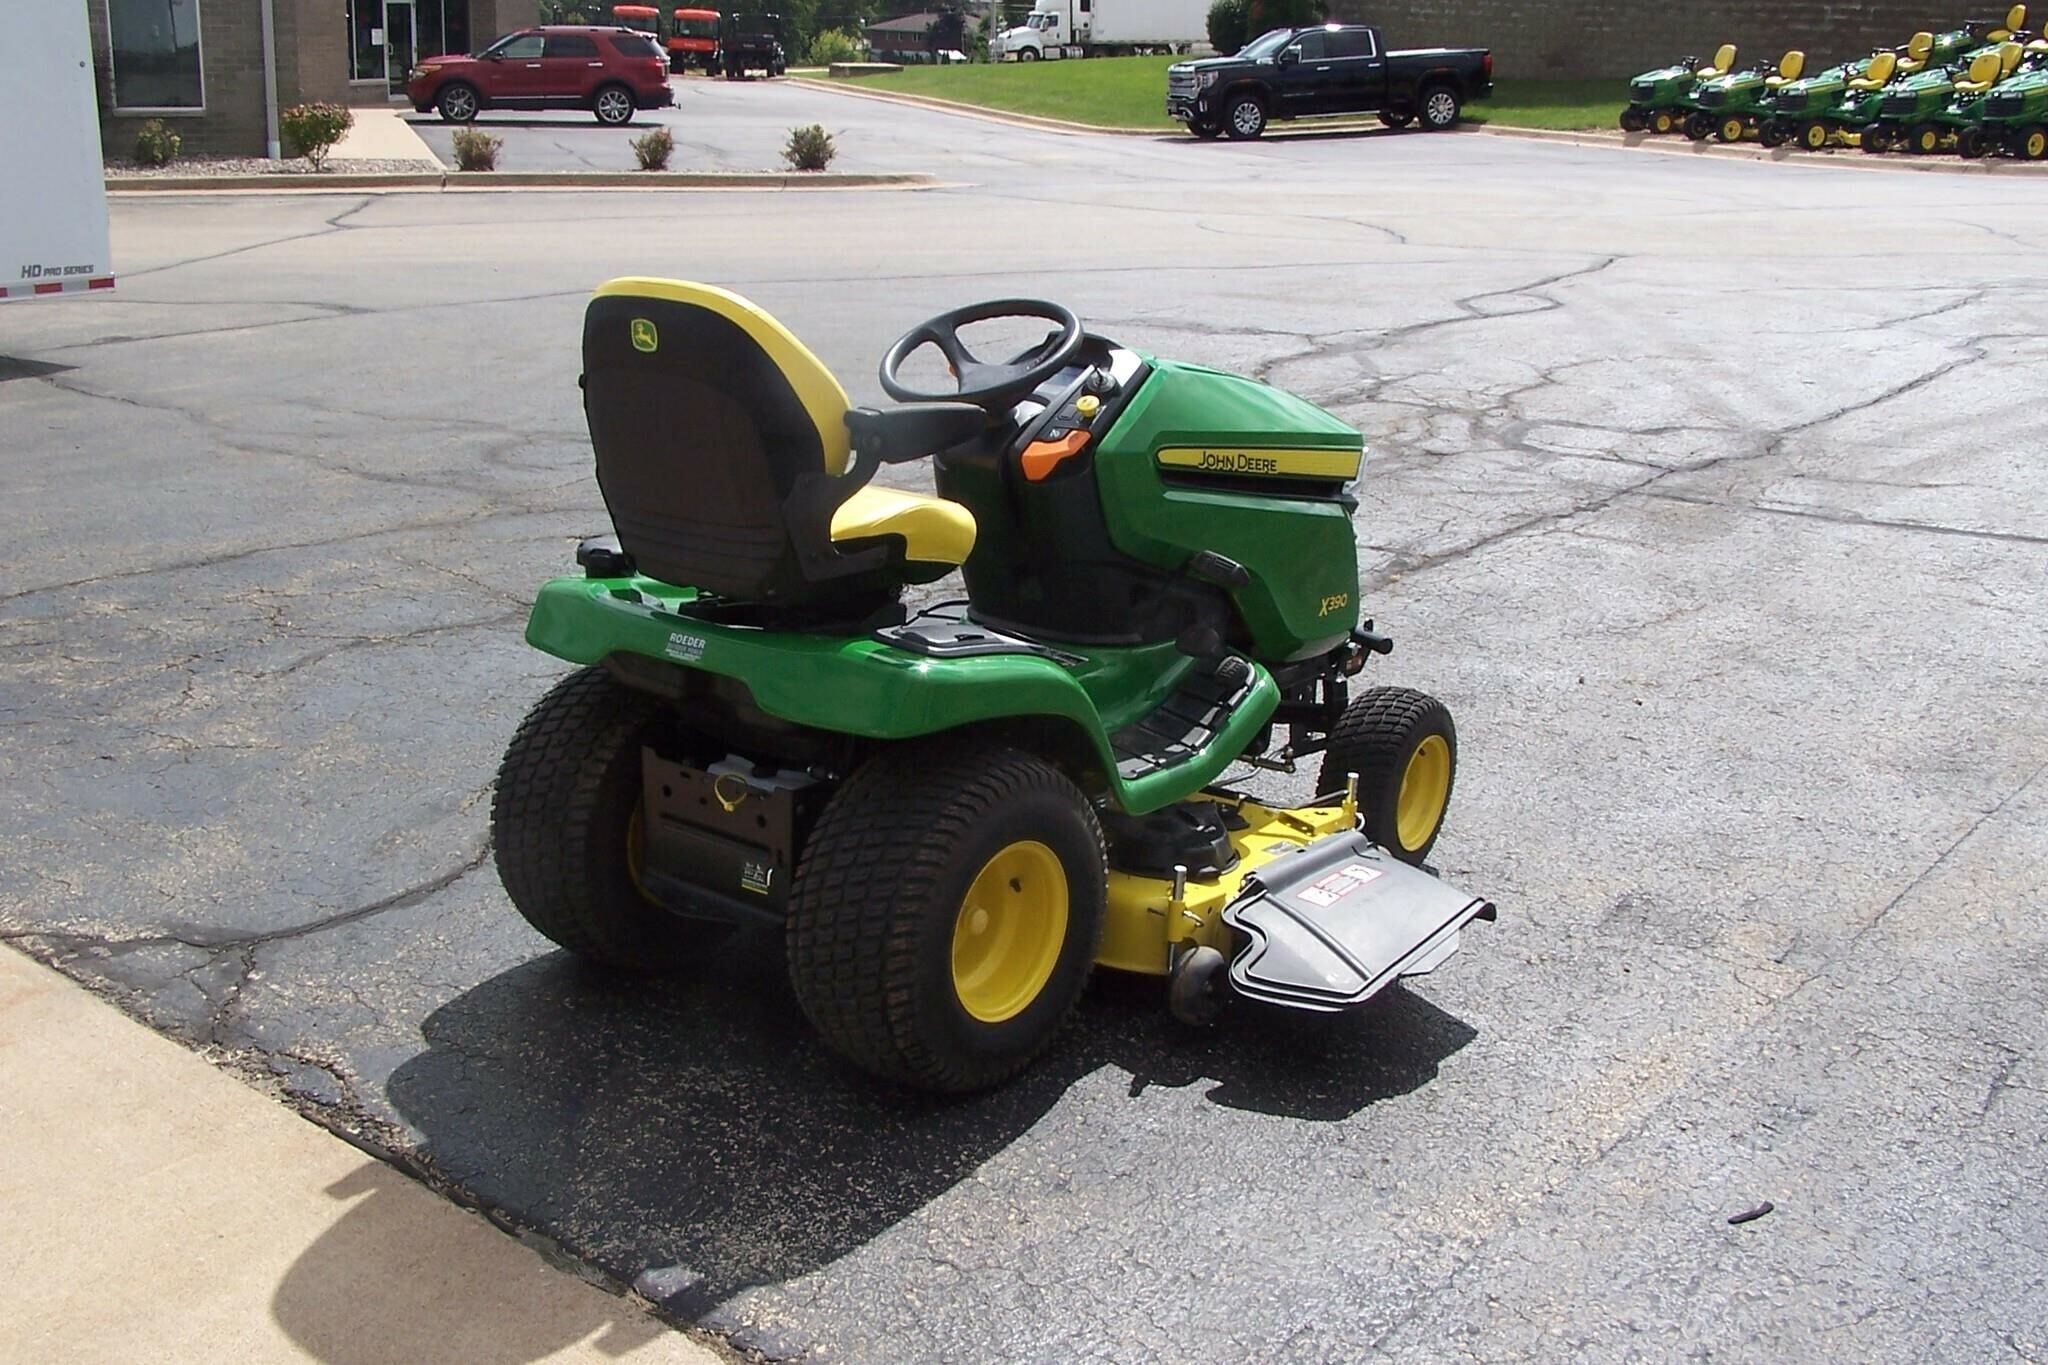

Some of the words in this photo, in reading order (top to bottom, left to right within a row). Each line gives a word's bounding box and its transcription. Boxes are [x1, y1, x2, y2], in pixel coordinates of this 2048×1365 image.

[21, 265, 42, 279] HD
[43, 267, 62, 277] PRO
[63, 264, 94, 275] SERIES
[1198, 450, 1235, 470] JOHN
[1238, 454, 1277, 472] DEERE
[1318, 593, 1347, 616] X390
[670, 632, 705, 649] ROEDER
